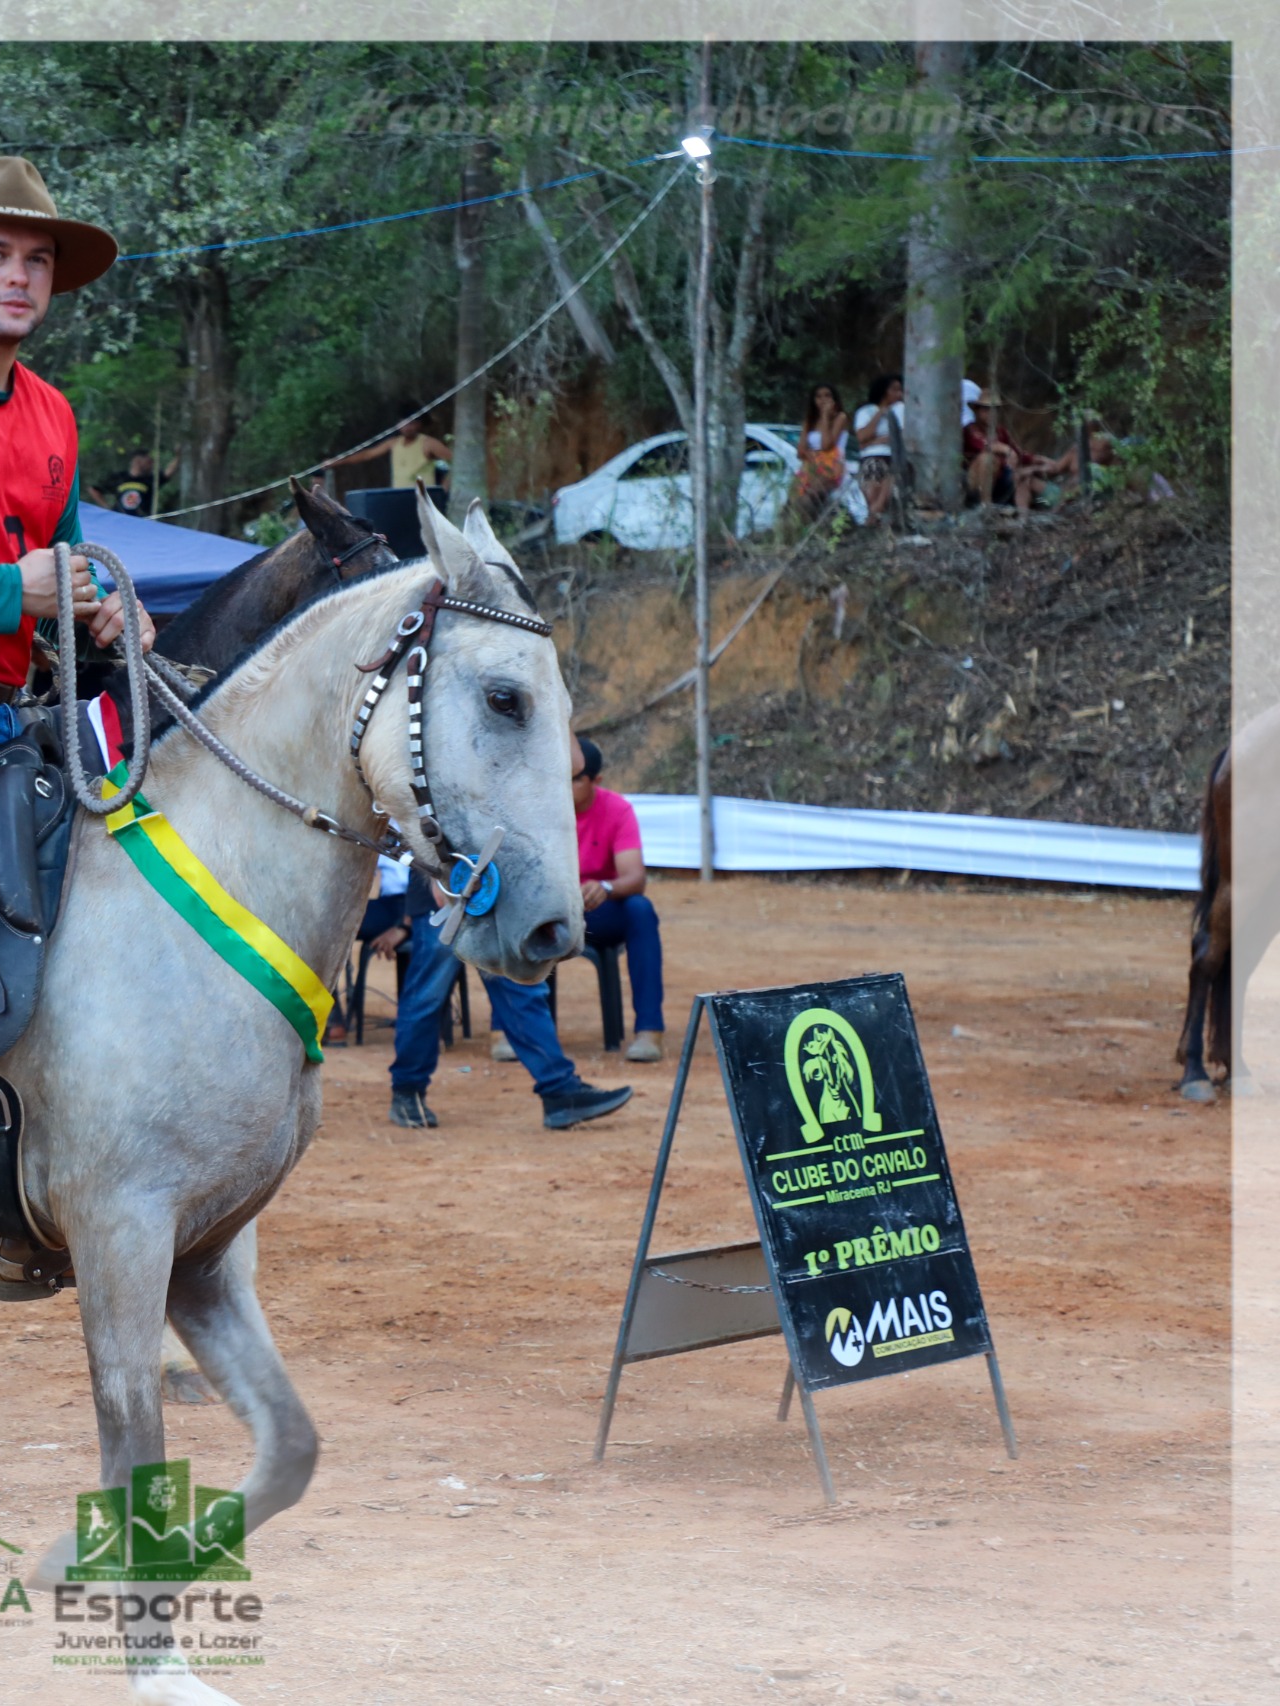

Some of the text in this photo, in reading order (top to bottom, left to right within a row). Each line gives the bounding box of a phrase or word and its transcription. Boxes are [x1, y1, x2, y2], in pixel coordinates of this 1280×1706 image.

[772, 1147, 927, 1194] CLUBE DO CAVALO
[826, 1180, 892, 1203] Miracema RJ
[833, 1224, 940, 1269] PRÊMIO
[865, 1290, 953, 1343] MAIS
